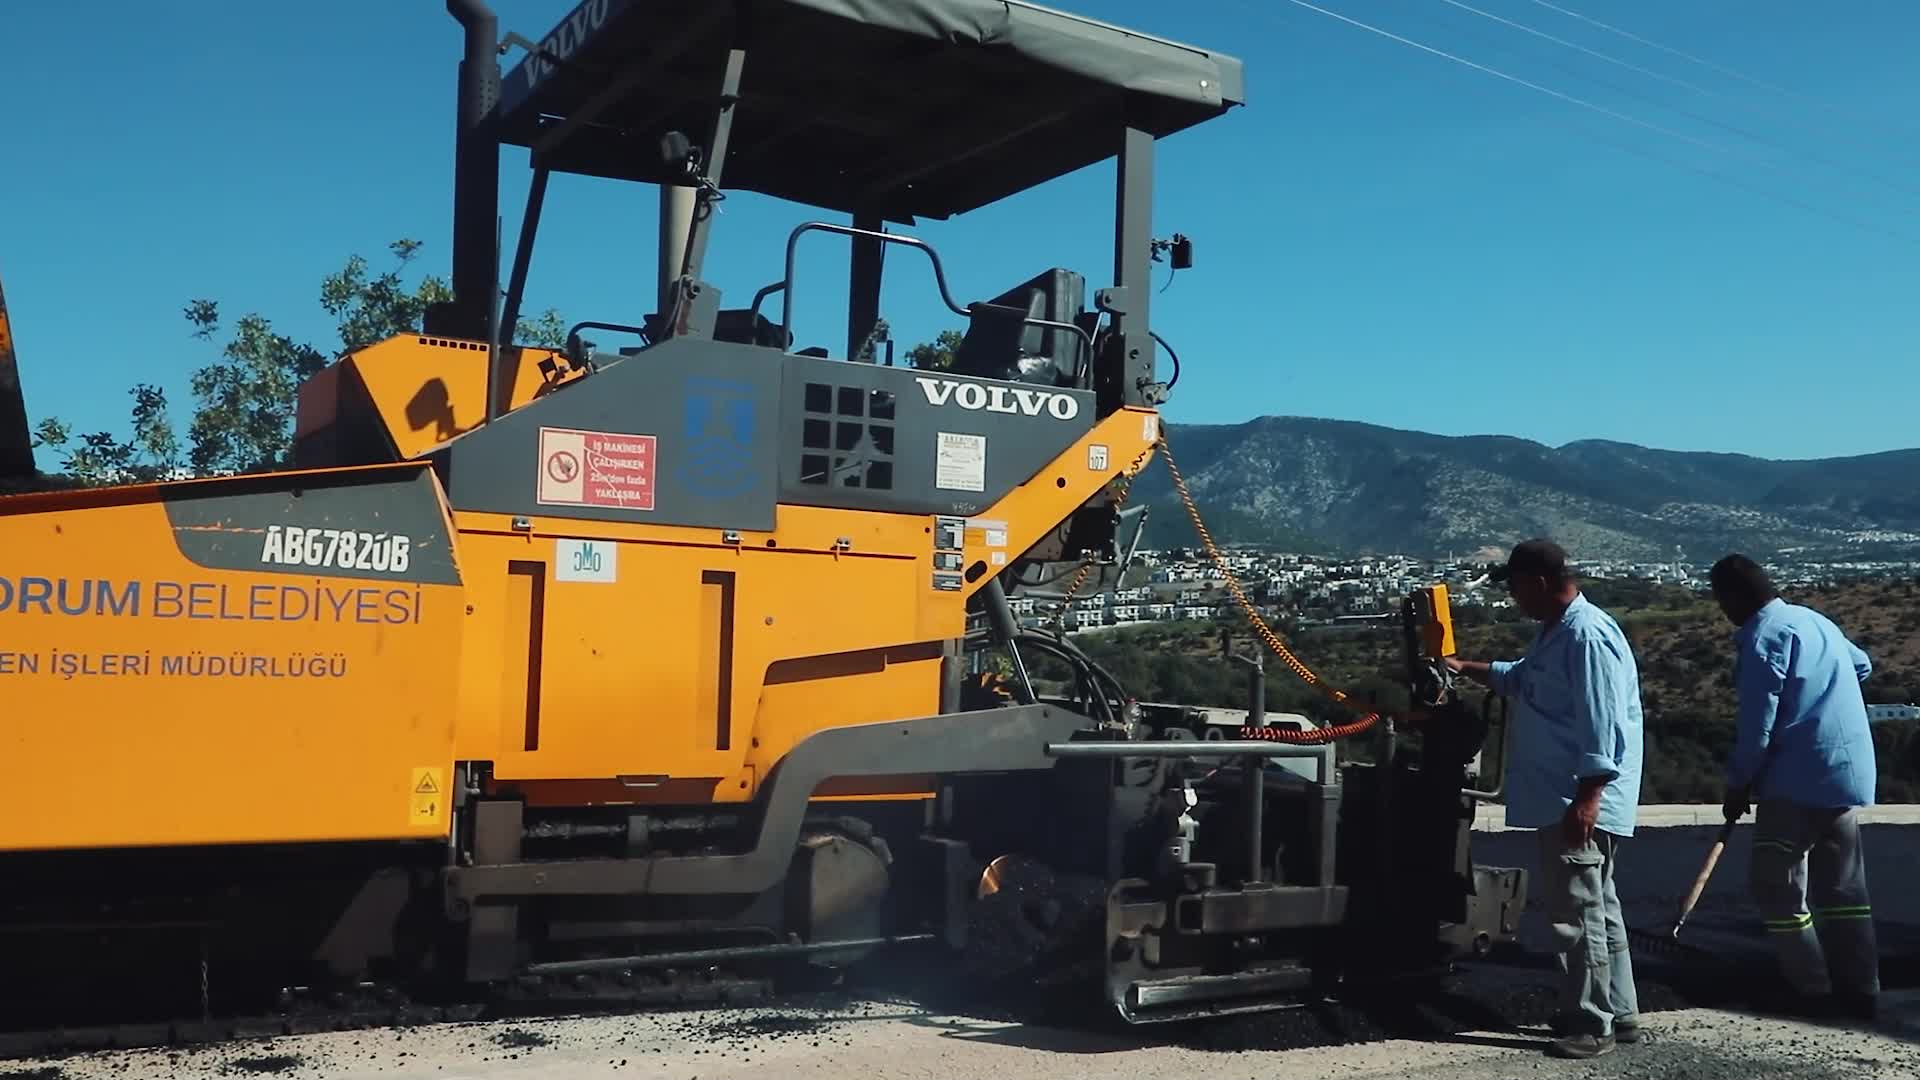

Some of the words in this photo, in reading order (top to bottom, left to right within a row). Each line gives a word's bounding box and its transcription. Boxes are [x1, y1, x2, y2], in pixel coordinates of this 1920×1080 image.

[523, 0, 609, 88] VOLVO
[916, 377, 1079, 421] VOLVO
[261, 525, 410, 573] ABG7820B
[153, 579, 422, 625] BELEDİYESİ
[51, 647, 150, 681] İŞLERİ
[161, 651, 347, 678] MÜDÜRLÜĞÜ
